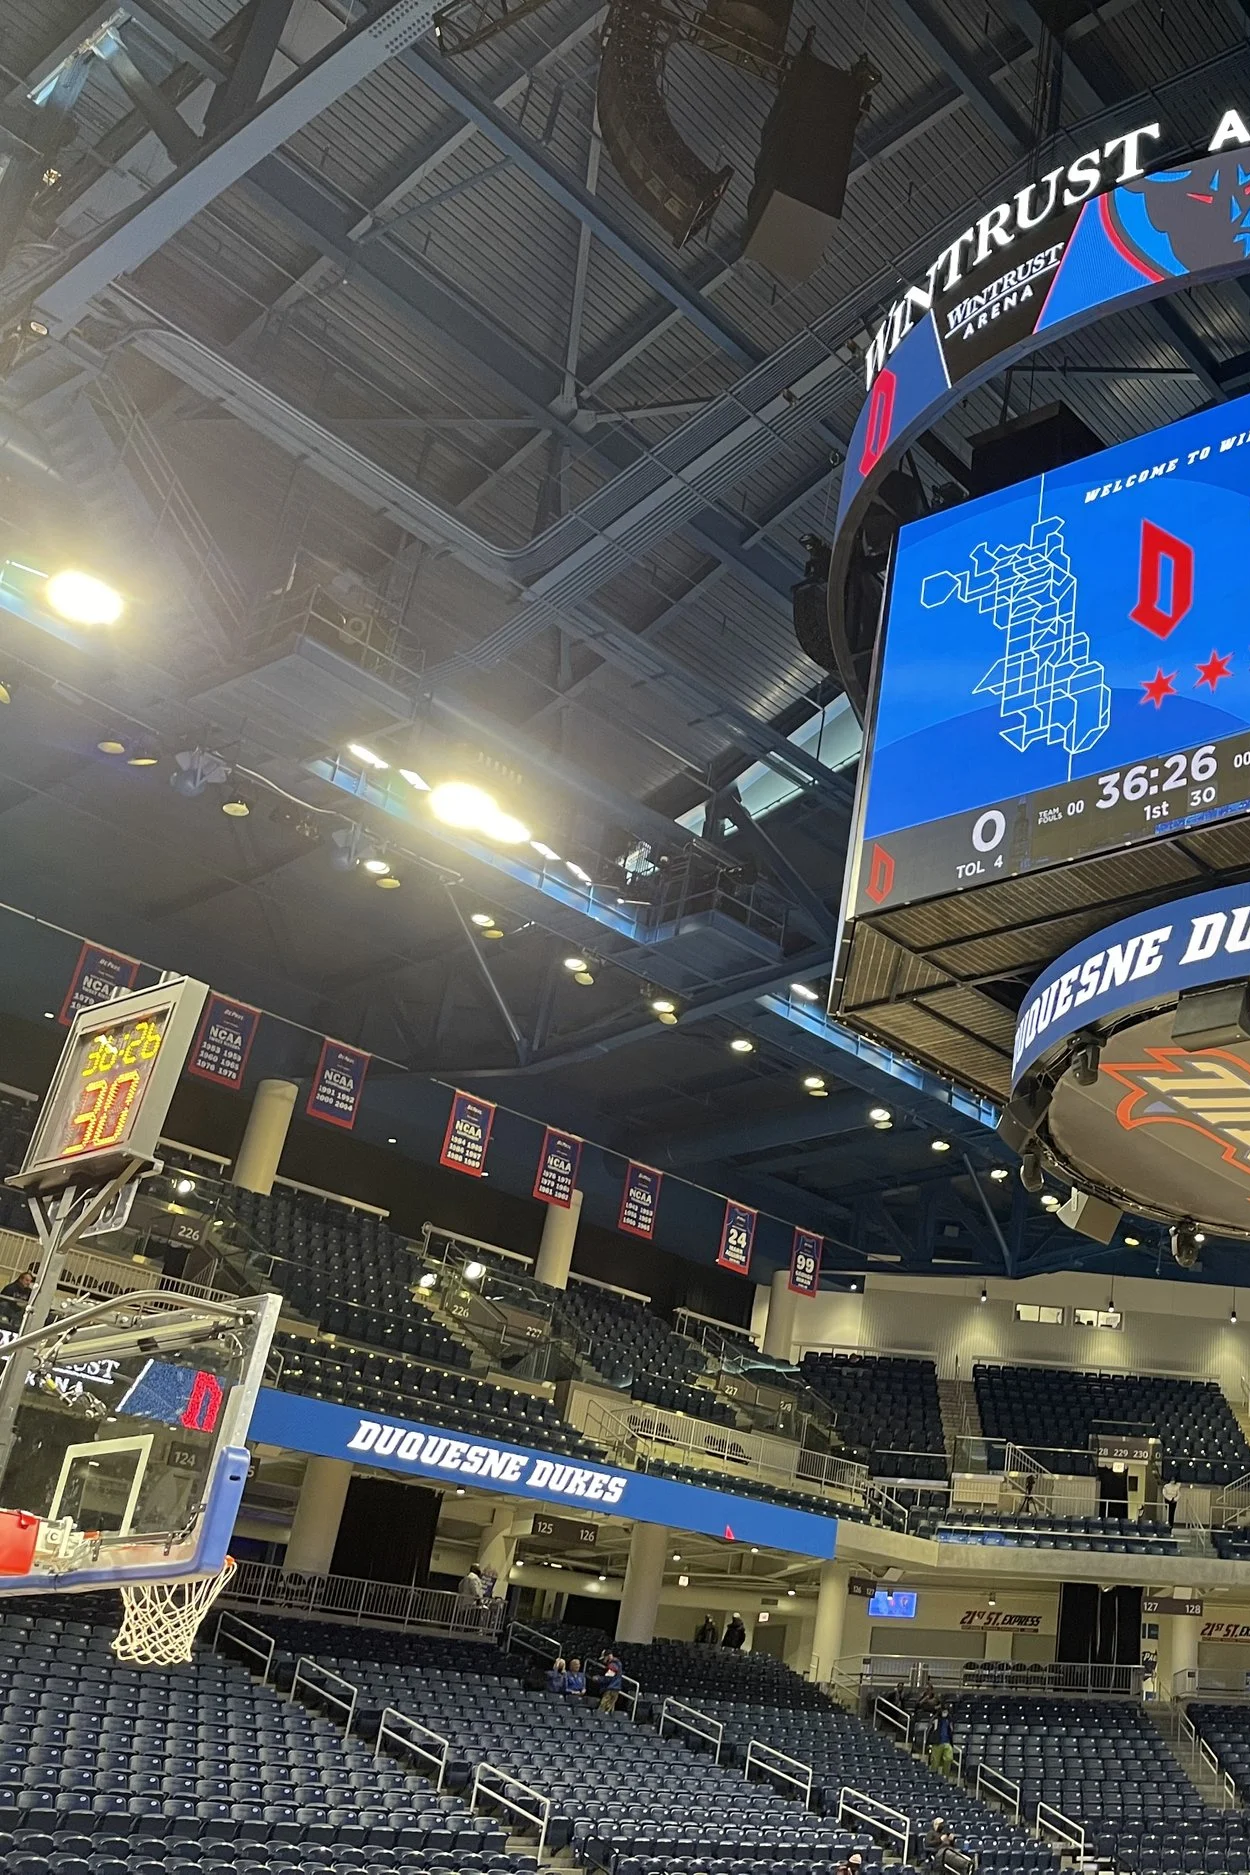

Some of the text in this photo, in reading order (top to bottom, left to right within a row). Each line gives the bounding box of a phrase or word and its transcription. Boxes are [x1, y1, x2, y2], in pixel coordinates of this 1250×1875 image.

[866, 124, 1162, 392] WINTRUST
[947, 242, 1065, 330] WINTRUST
[963, 285, 1034, 339] ARENA
[1083, 459, 1179, 504] WELCOME
[1187, 446, 1211, 465] TO
[1096, 745, 1217, 809] 36:26
[1038, 806, 1060, 819] TEAM
[1066, 800, 1085, 817] 00
[1143, 786, 1216, 821] 1st 30
[1037, 812, 1063, 825] FOULS
[972, 809, 1006, 853] 0
[956, 854, 1003, 879] TOL 4
[83, 975, 113, 997] NCA
[210, 1026, 243, 1047] NCAA
[82, 1022, 161, 1077] 36:26
[324, 1069, 354, 1089] NCAA
[63, 1069, 140, 1154] 30
[455, 1120, 482, 1139] NCAA
[547, 1155, 571, 1172] NCAA
[629, 1188, 652, 1204] NCAA
[178, 1225, 200, 1241] 226
[728, 1228, 747, 1248] 24
[796, 1254, 815, 1273] 99
[452, 1304, 469, 1318] 226
[526, 1326, 542, 1338] 227
[724, 1384, 738, 1396] 227
[174, 1451, 196, 1467] 124
[347, 1419, 628, 1503] DUQUESNE DUKES
[1113, 1448, 1129, 1457] 229
[1133, 1450, 1149, 1459] 230
[537, 1521, 595, 1542] 125 126
[853, 1585, 875, 1596] 126 127
[1143, 1601, 1201, 1614] 127 128
[960, 1611, 987, 1625] 21ST
[1001, 1615, 1043, 1627] EXPRESS
[1200, 1622, 1225, 1636] 21ST
[1222, 1624, 1240, 1638] ST.
